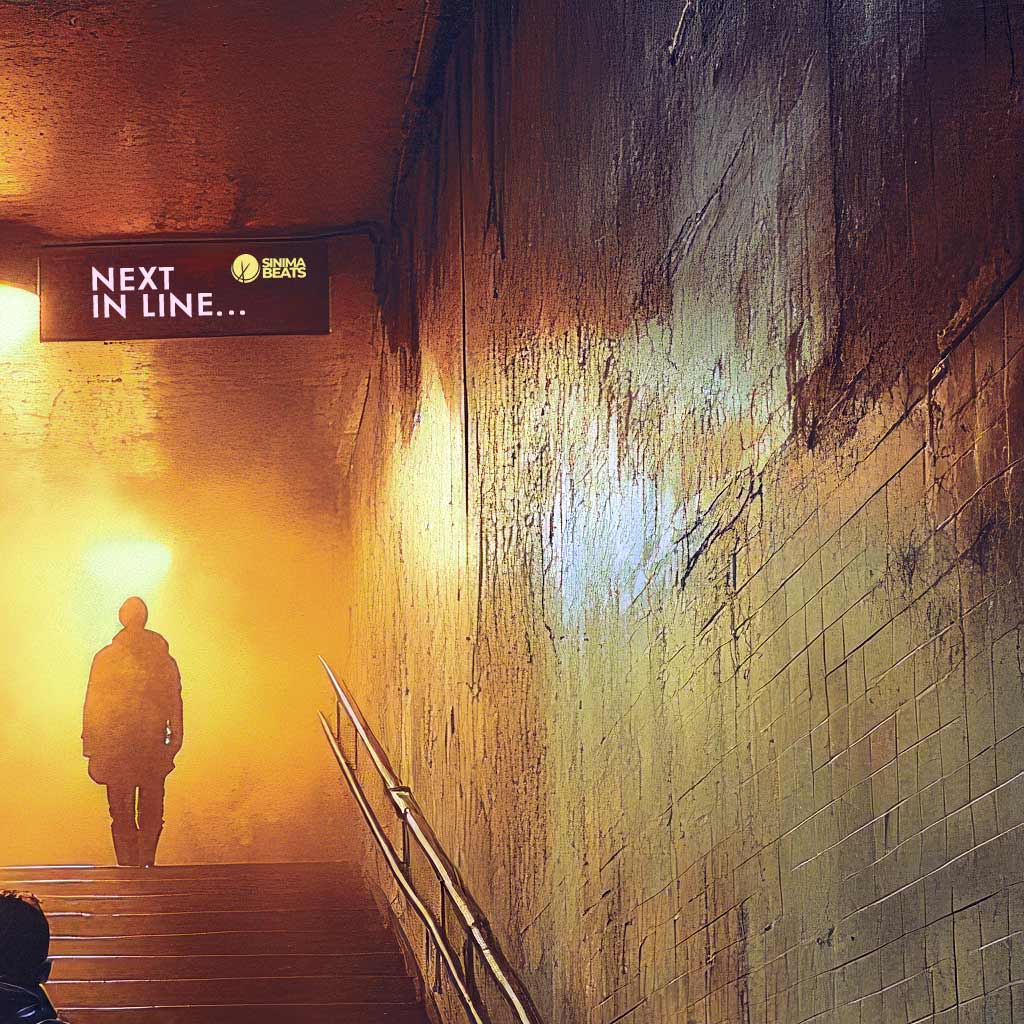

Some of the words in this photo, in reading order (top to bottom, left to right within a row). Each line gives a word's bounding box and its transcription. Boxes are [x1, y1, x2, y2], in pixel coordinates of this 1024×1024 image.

[262, 257, 306, 268] SINIMA
[91, 266, 175, 292] NEXT
[262, 267, 307, 279] BEATS
[92, 293, 127, 319] IN
[142, 292, 246, 318] LINE...
